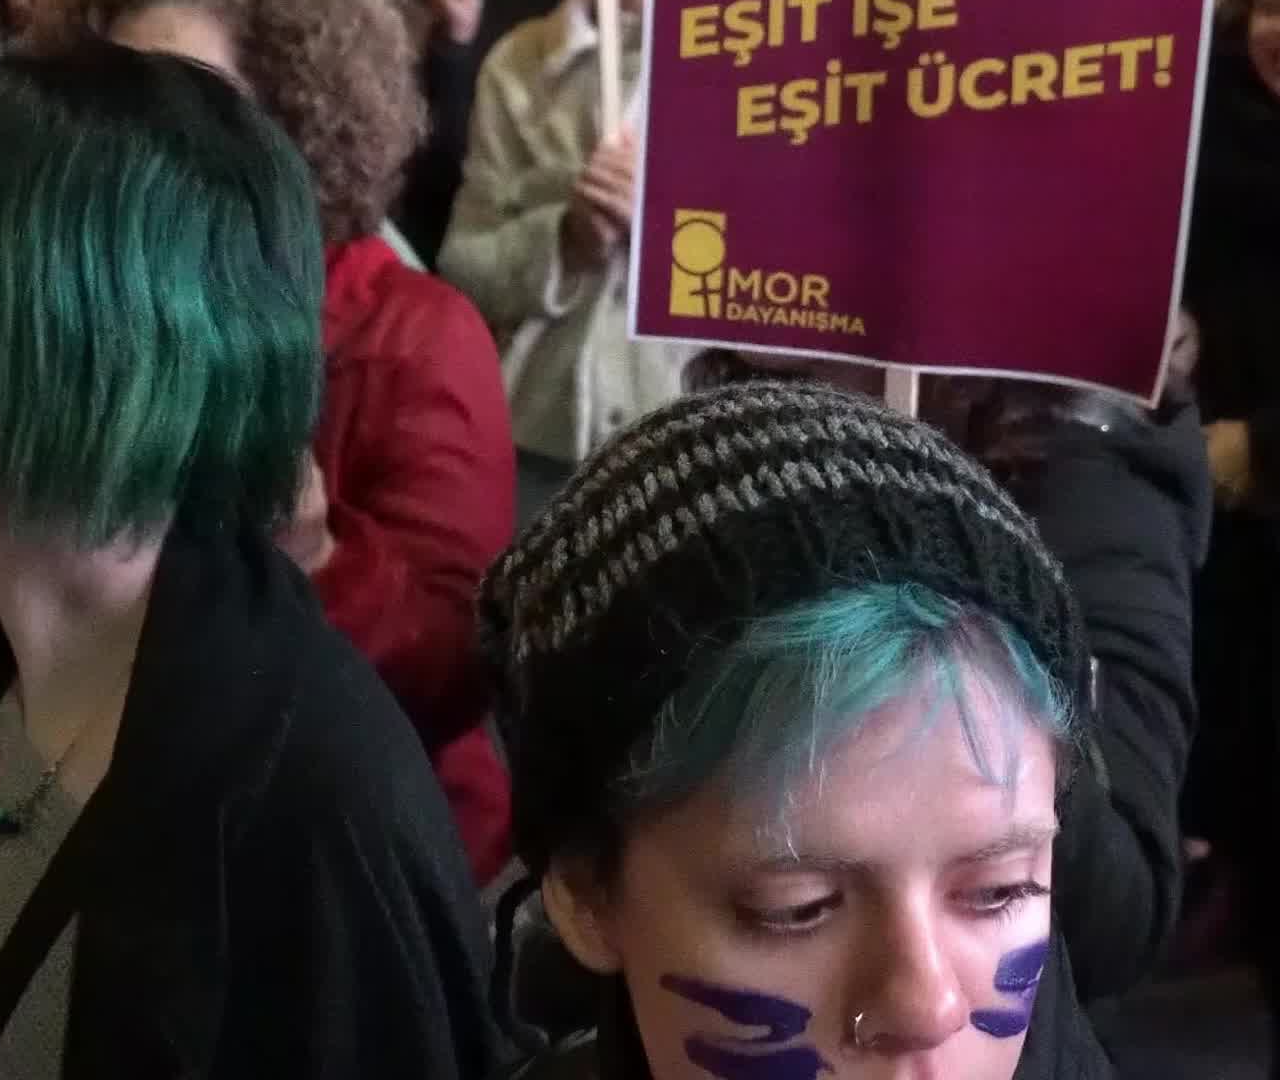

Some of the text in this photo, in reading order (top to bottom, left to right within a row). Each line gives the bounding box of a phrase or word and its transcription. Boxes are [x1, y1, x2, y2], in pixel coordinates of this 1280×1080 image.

[736, 33, 1176, 146] EŞİT ÜCRET!
[726, 267, 831, 308] MOR
[725, 301, 867, 338] DAYANIŞMA
